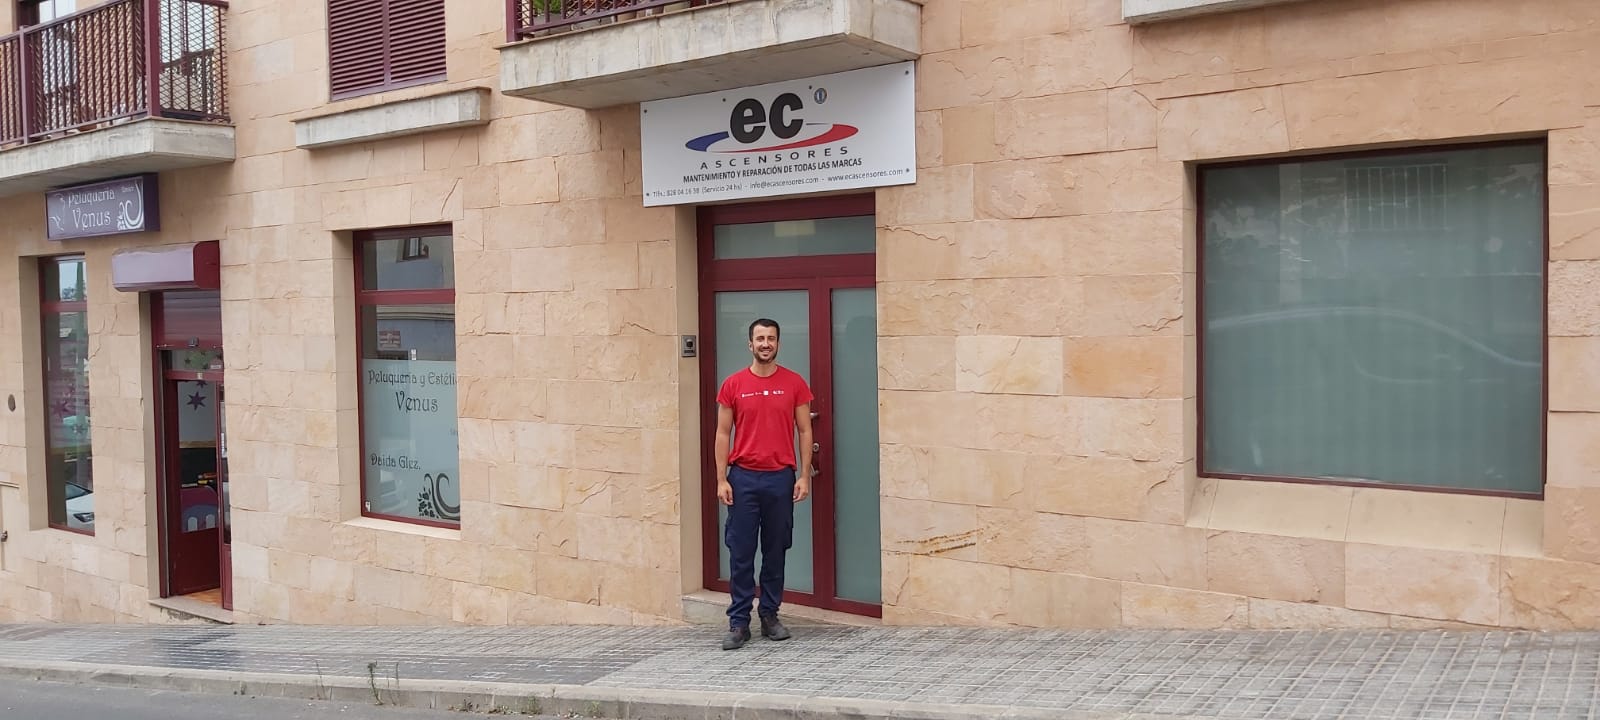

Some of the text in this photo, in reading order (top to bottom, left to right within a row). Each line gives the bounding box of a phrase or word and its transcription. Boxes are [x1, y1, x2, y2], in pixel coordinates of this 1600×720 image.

[730, 92, 804, 144] ec
[700, 146, 848, 170] ASCENSORES
[683, 158, 862, 183] MANTENIMIENTO Y REPARACIÓN DE TODAS LAS MARCAS
[701, 184, 725, 195] (Servicio
[725, 184, 733, 192] 24
[750, 176, 819, 190] info@ecascensores.com
[828, 168, 903, 182] www.ecascensores.com
[72, 207, 111, 231] Venus
[419, 375, 426, 388] y
[395, 390, 439, 414] Venus
